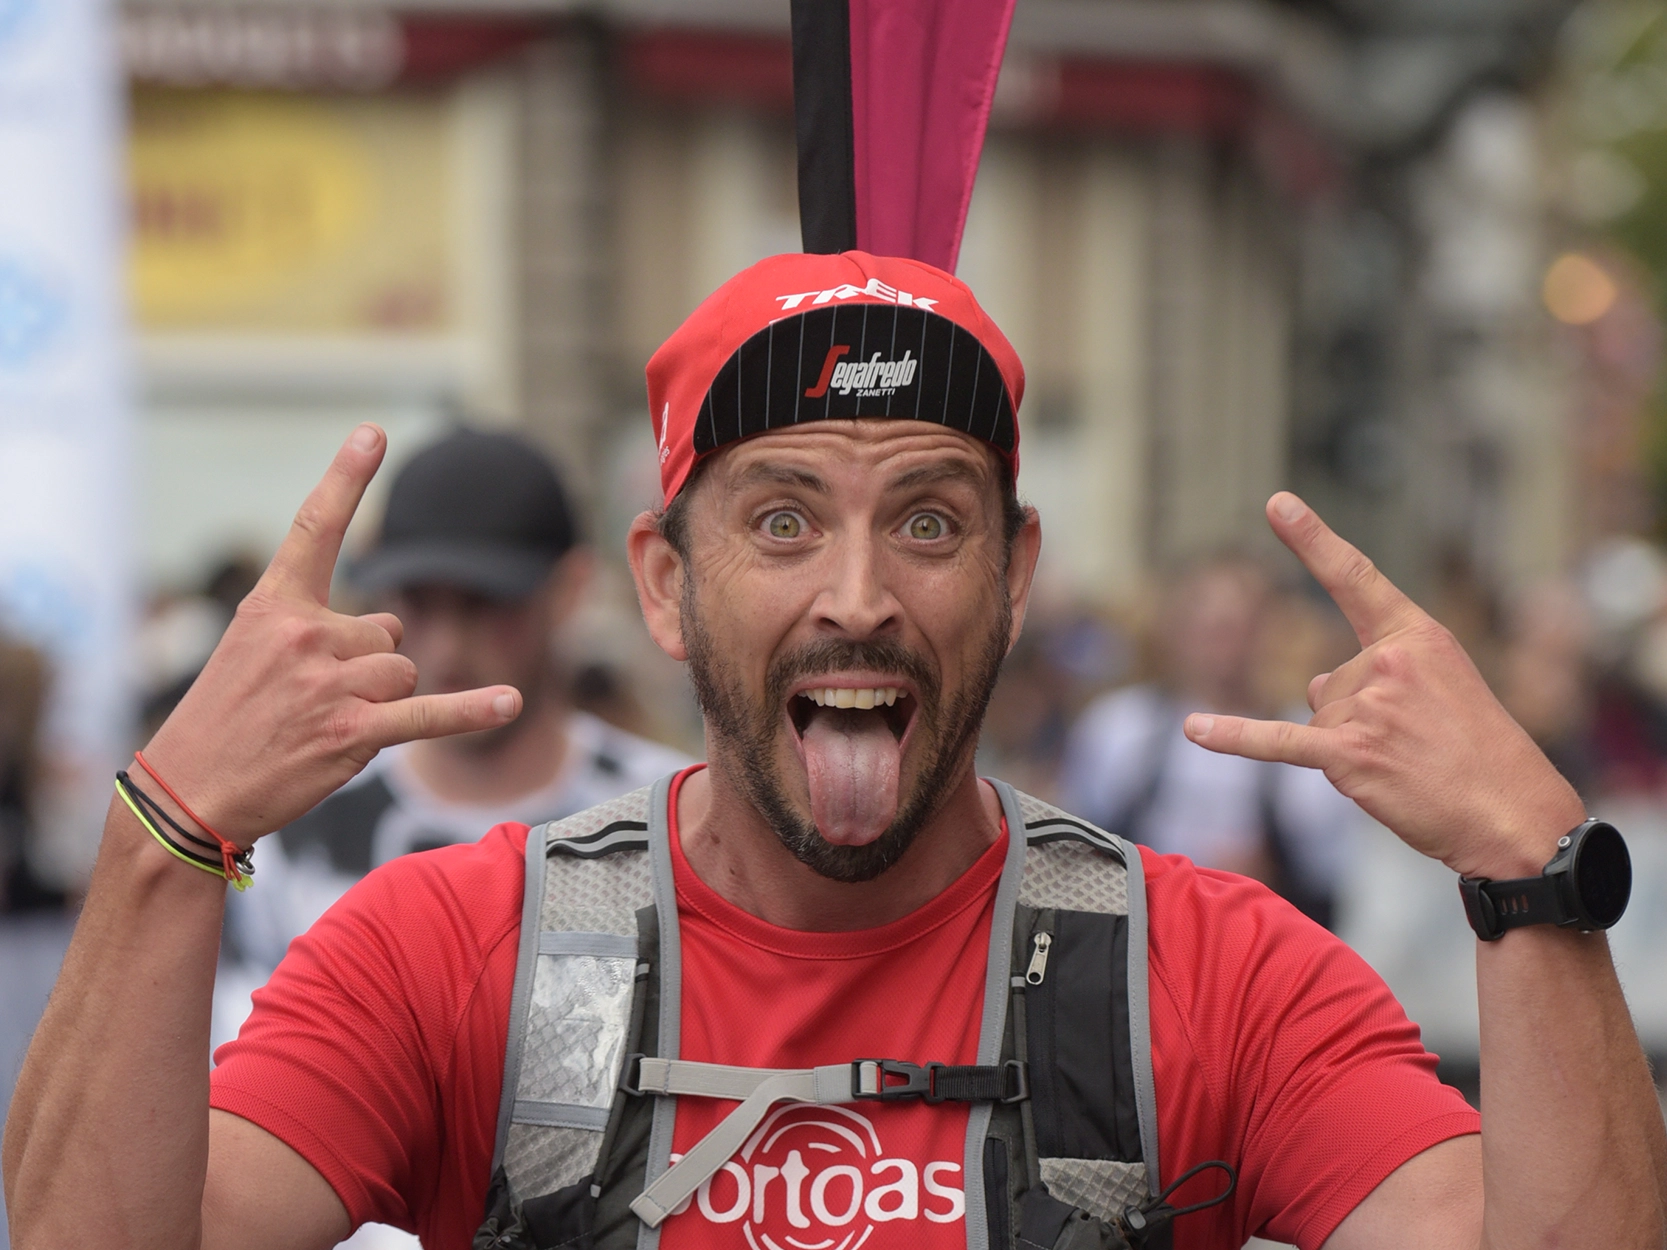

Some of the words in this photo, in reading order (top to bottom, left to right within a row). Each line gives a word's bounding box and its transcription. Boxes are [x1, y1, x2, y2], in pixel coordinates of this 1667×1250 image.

[775, 278, 939, 312] TREK
[804, 344, 918, 398] Segafredo
[856, 388, 895, 397] ZANETTI
